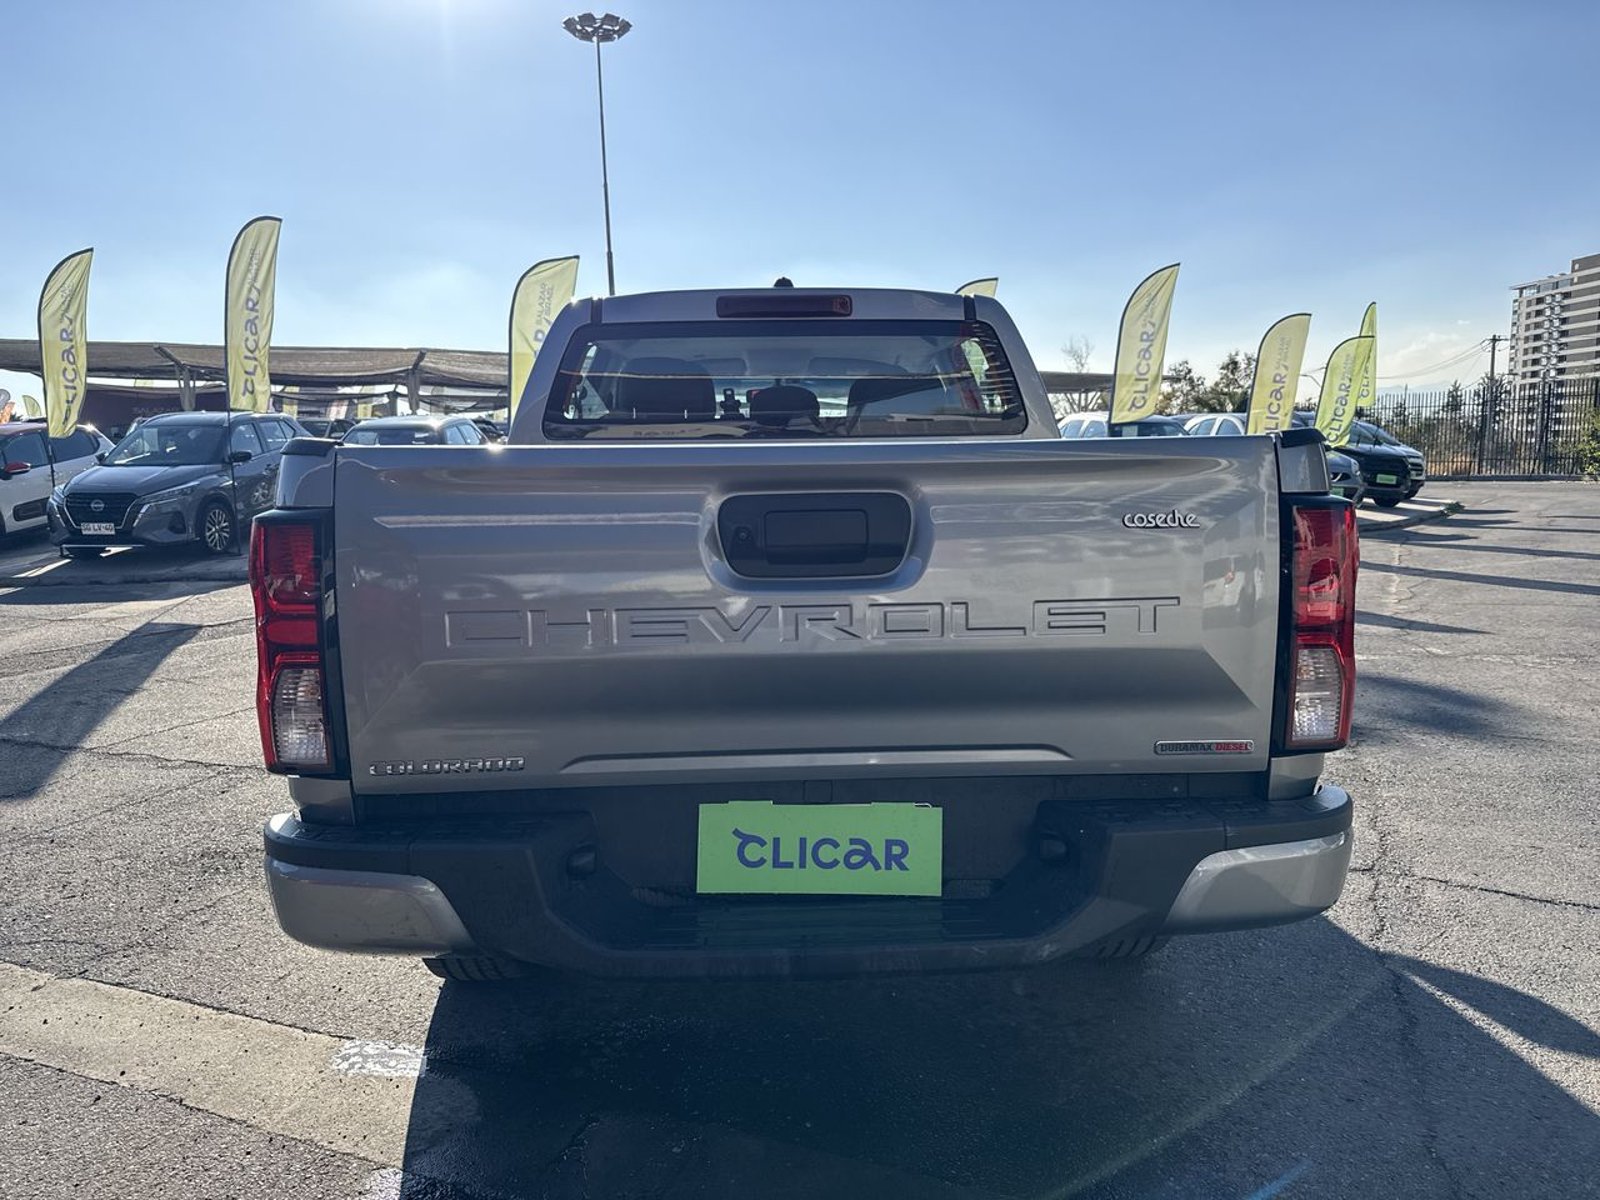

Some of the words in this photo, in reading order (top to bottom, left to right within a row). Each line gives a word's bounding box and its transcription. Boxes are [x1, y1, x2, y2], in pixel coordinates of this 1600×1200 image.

[1122, 509, 1200, 529] coseche
[446, 596, 1182, 648] CHEVROLET
[1160, 742, 1212, 752] DURAMAX
[1215, 742, 1252, 751] DIESEL
[369, 756, 526, 776] COLORADO
